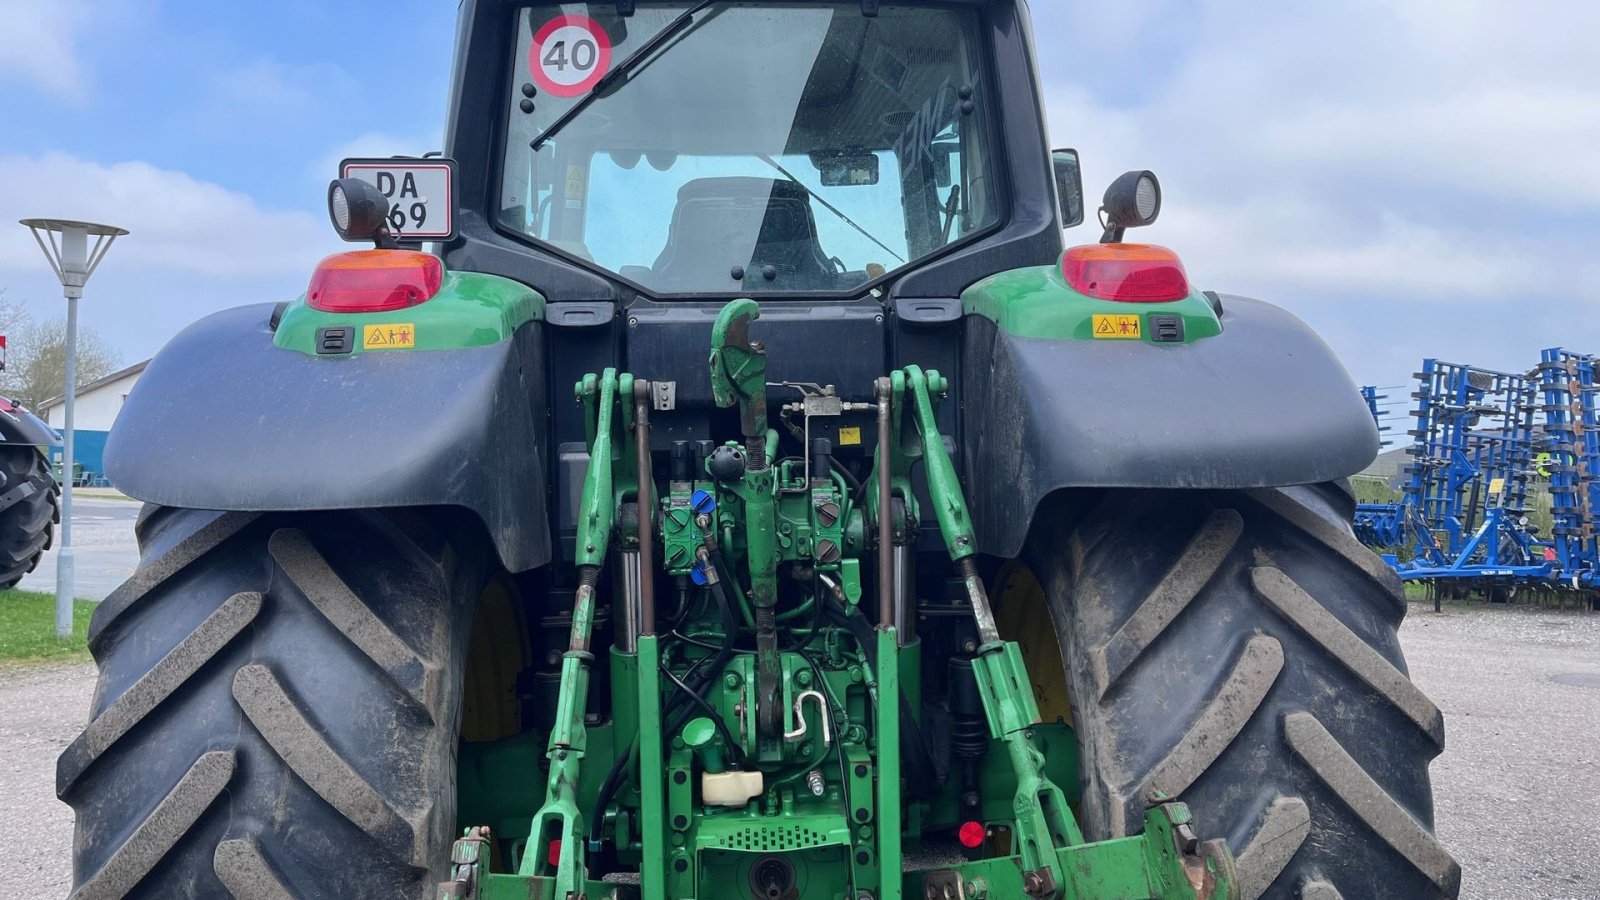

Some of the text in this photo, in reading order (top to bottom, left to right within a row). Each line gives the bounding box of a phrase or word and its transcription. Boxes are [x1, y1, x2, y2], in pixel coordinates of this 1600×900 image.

[543, 39, 596, 71] 40
[377, 172, 418, 198] DA
[390, 203, 427, 229] 69
